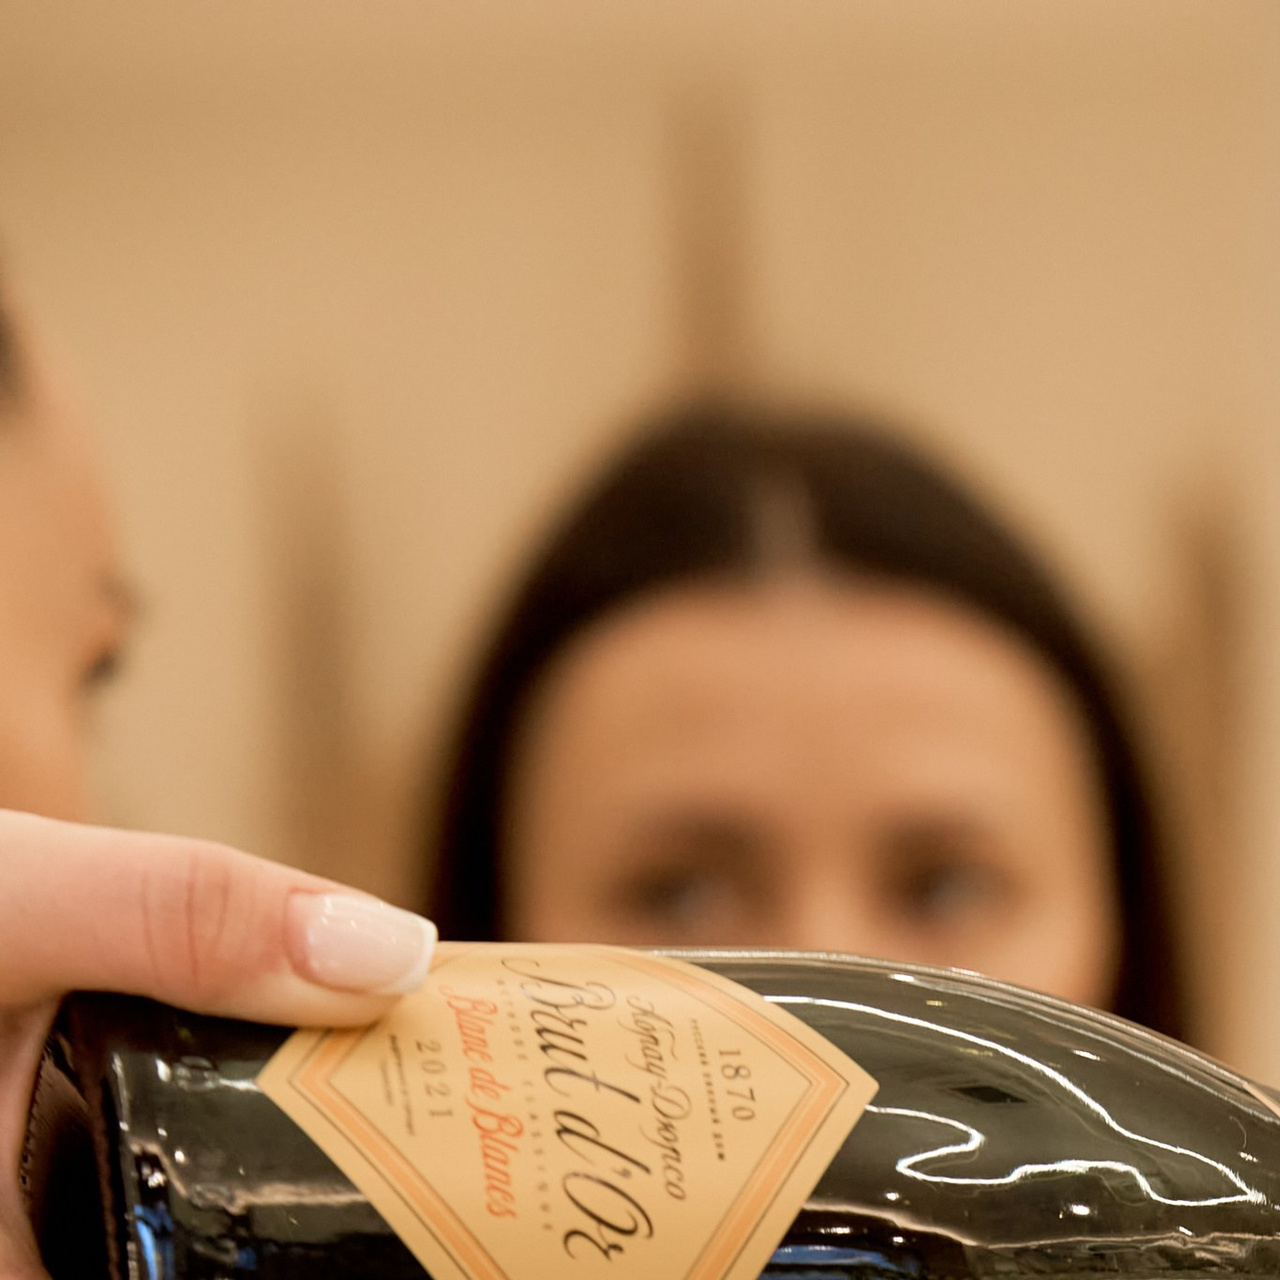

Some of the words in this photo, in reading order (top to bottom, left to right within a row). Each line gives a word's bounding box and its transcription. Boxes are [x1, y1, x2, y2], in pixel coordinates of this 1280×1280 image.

[438, 985, 499, 1063] Blanc
[501, 958, 641, 1103] Brut
[416, 1039, 453, 1117] 2021
[469, 1066, 511, 1101] de
[719, 1049, 756, 1121] 1870
[465, 1096, 524, 1219] Blancs
[553, 1109, 654, 1261] d'Or
